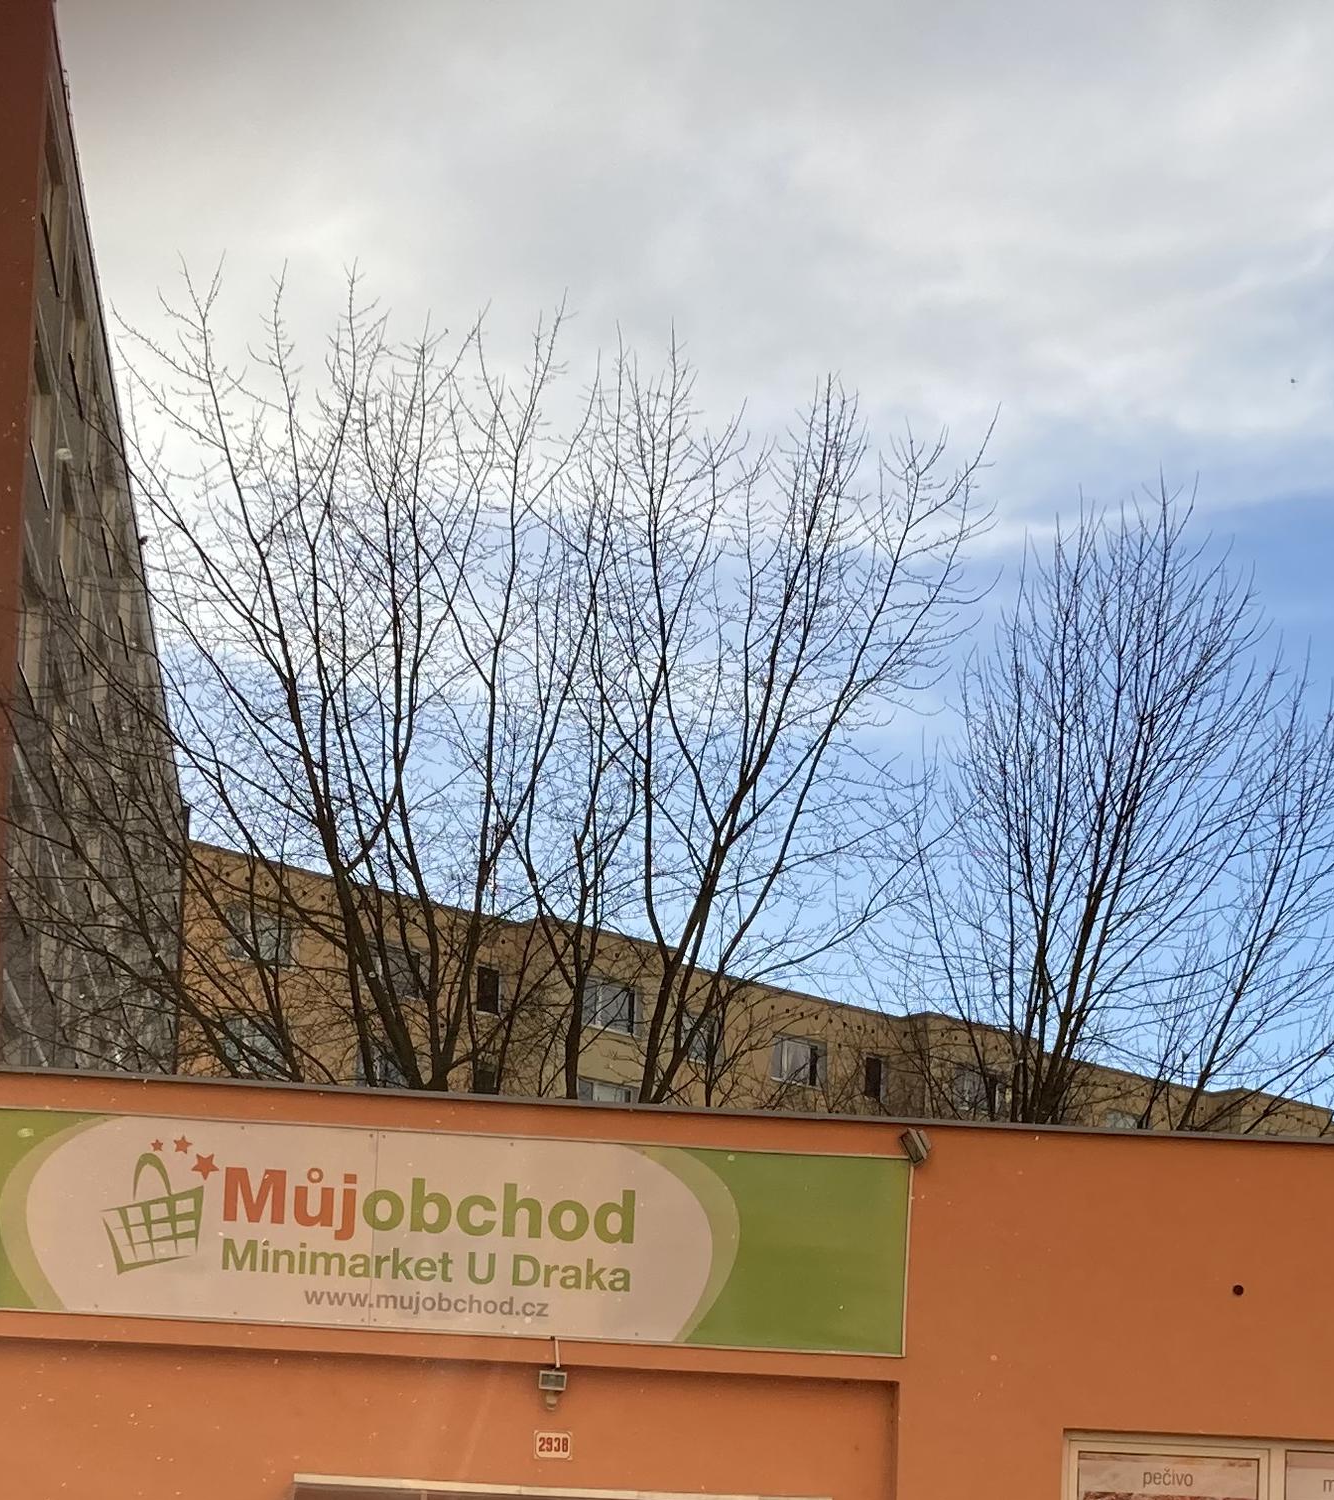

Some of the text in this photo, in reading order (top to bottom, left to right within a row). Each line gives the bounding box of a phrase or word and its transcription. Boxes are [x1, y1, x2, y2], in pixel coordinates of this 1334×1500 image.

[222, 1166, 636, 1245] Můjobchod
[221, 1238, 632, 1293] Minimarket U Draka
[304, 1287, 550, 1318] www.mujobchod.cz
[538, 1436, 569, 1453] 2938
[1143, 1467, 1194, 1488] pečivo
